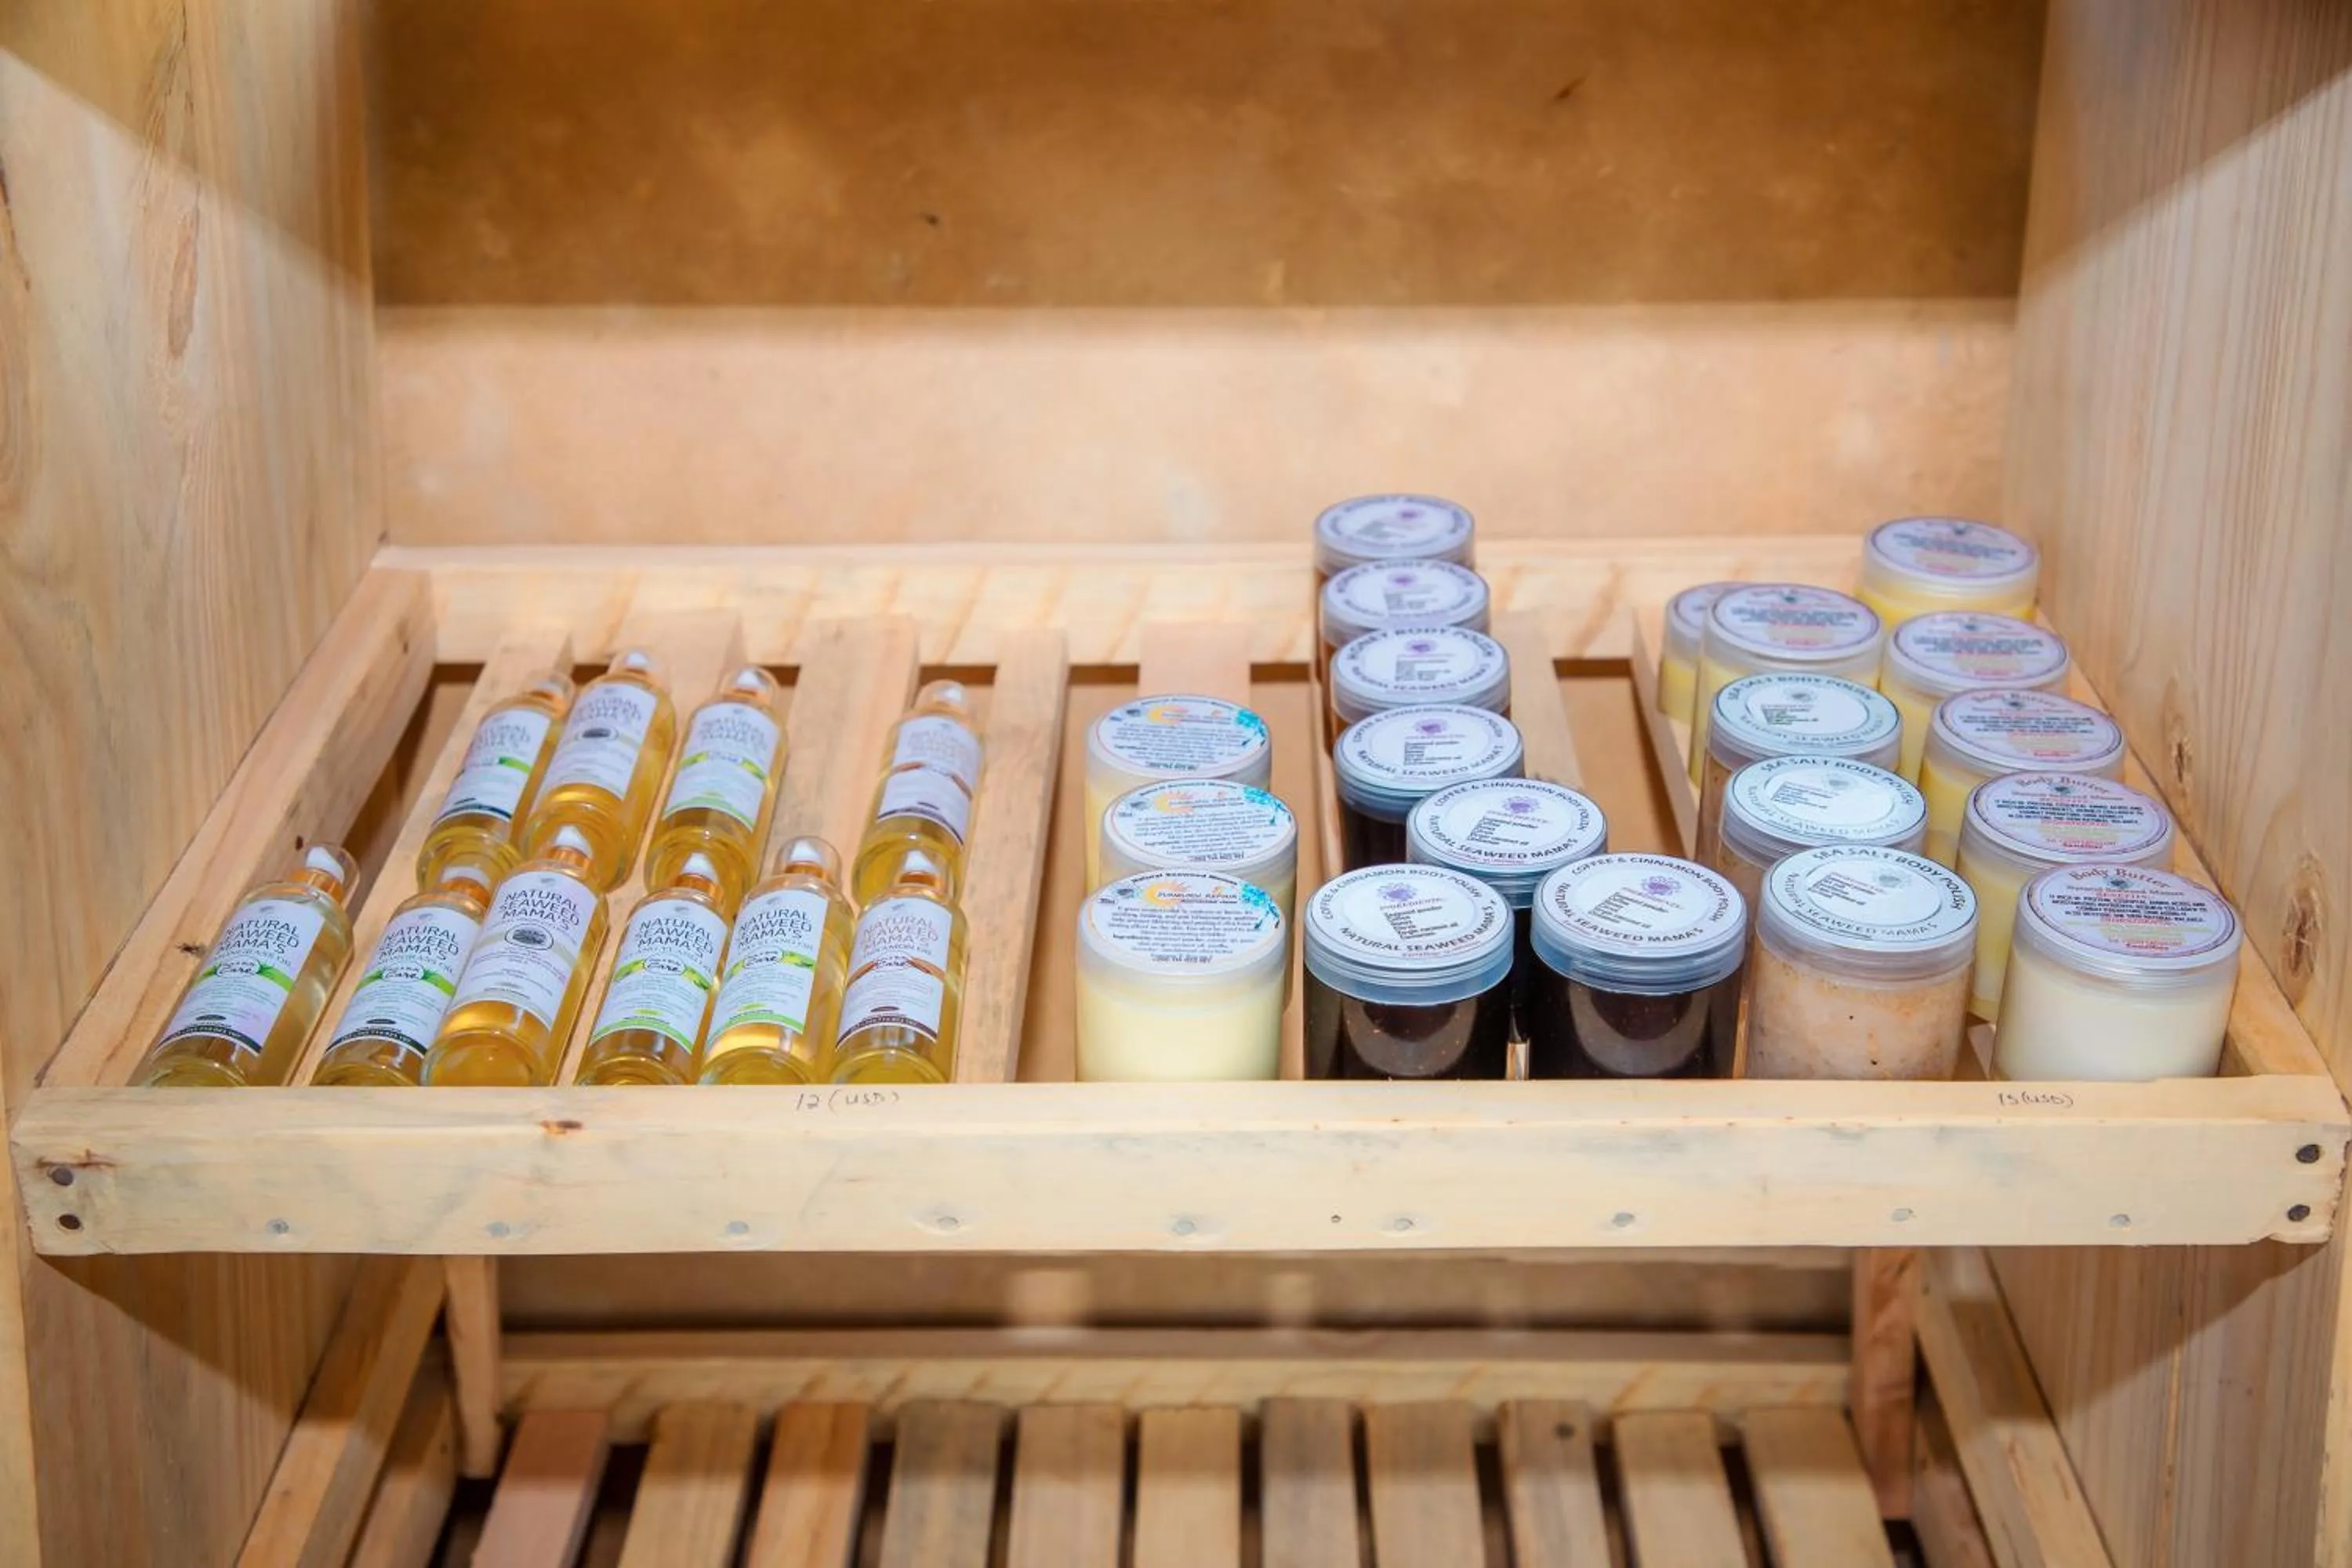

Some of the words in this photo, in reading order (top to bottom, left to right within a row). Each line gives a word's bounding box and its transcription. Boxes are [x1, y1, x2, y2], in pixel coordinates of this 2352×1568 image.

[1791, 757, 1830, 766] SALT
[1834, 761, 1882, 777] BODY
[1458, 843, 1528, 859] SEAWEED
[1630, 857, 1704, 880] CINNAMON
[1812, 848, 1844, 861] SEA
[1848, 848, 1890, 858] SALT
[1894, 855, 1943, 877] BODY
[1409, 869, 1446, 879] BODY
[2070, 868, 2109, 881] Body
[2115, 868, 2172, 888] Butter
[504, 890, 579, 912] NATURAL
[499, 899, 580, 926] SEAWEED
[502, 909, 570, 931] MAMA'S
[383, 926, 457, 943] NATURAL
[640, 917, 711, 940] NATURAL
[1339, 927, 1401, 951] NATURAL
[1406, 933, 1475, 952] SEAWEED
